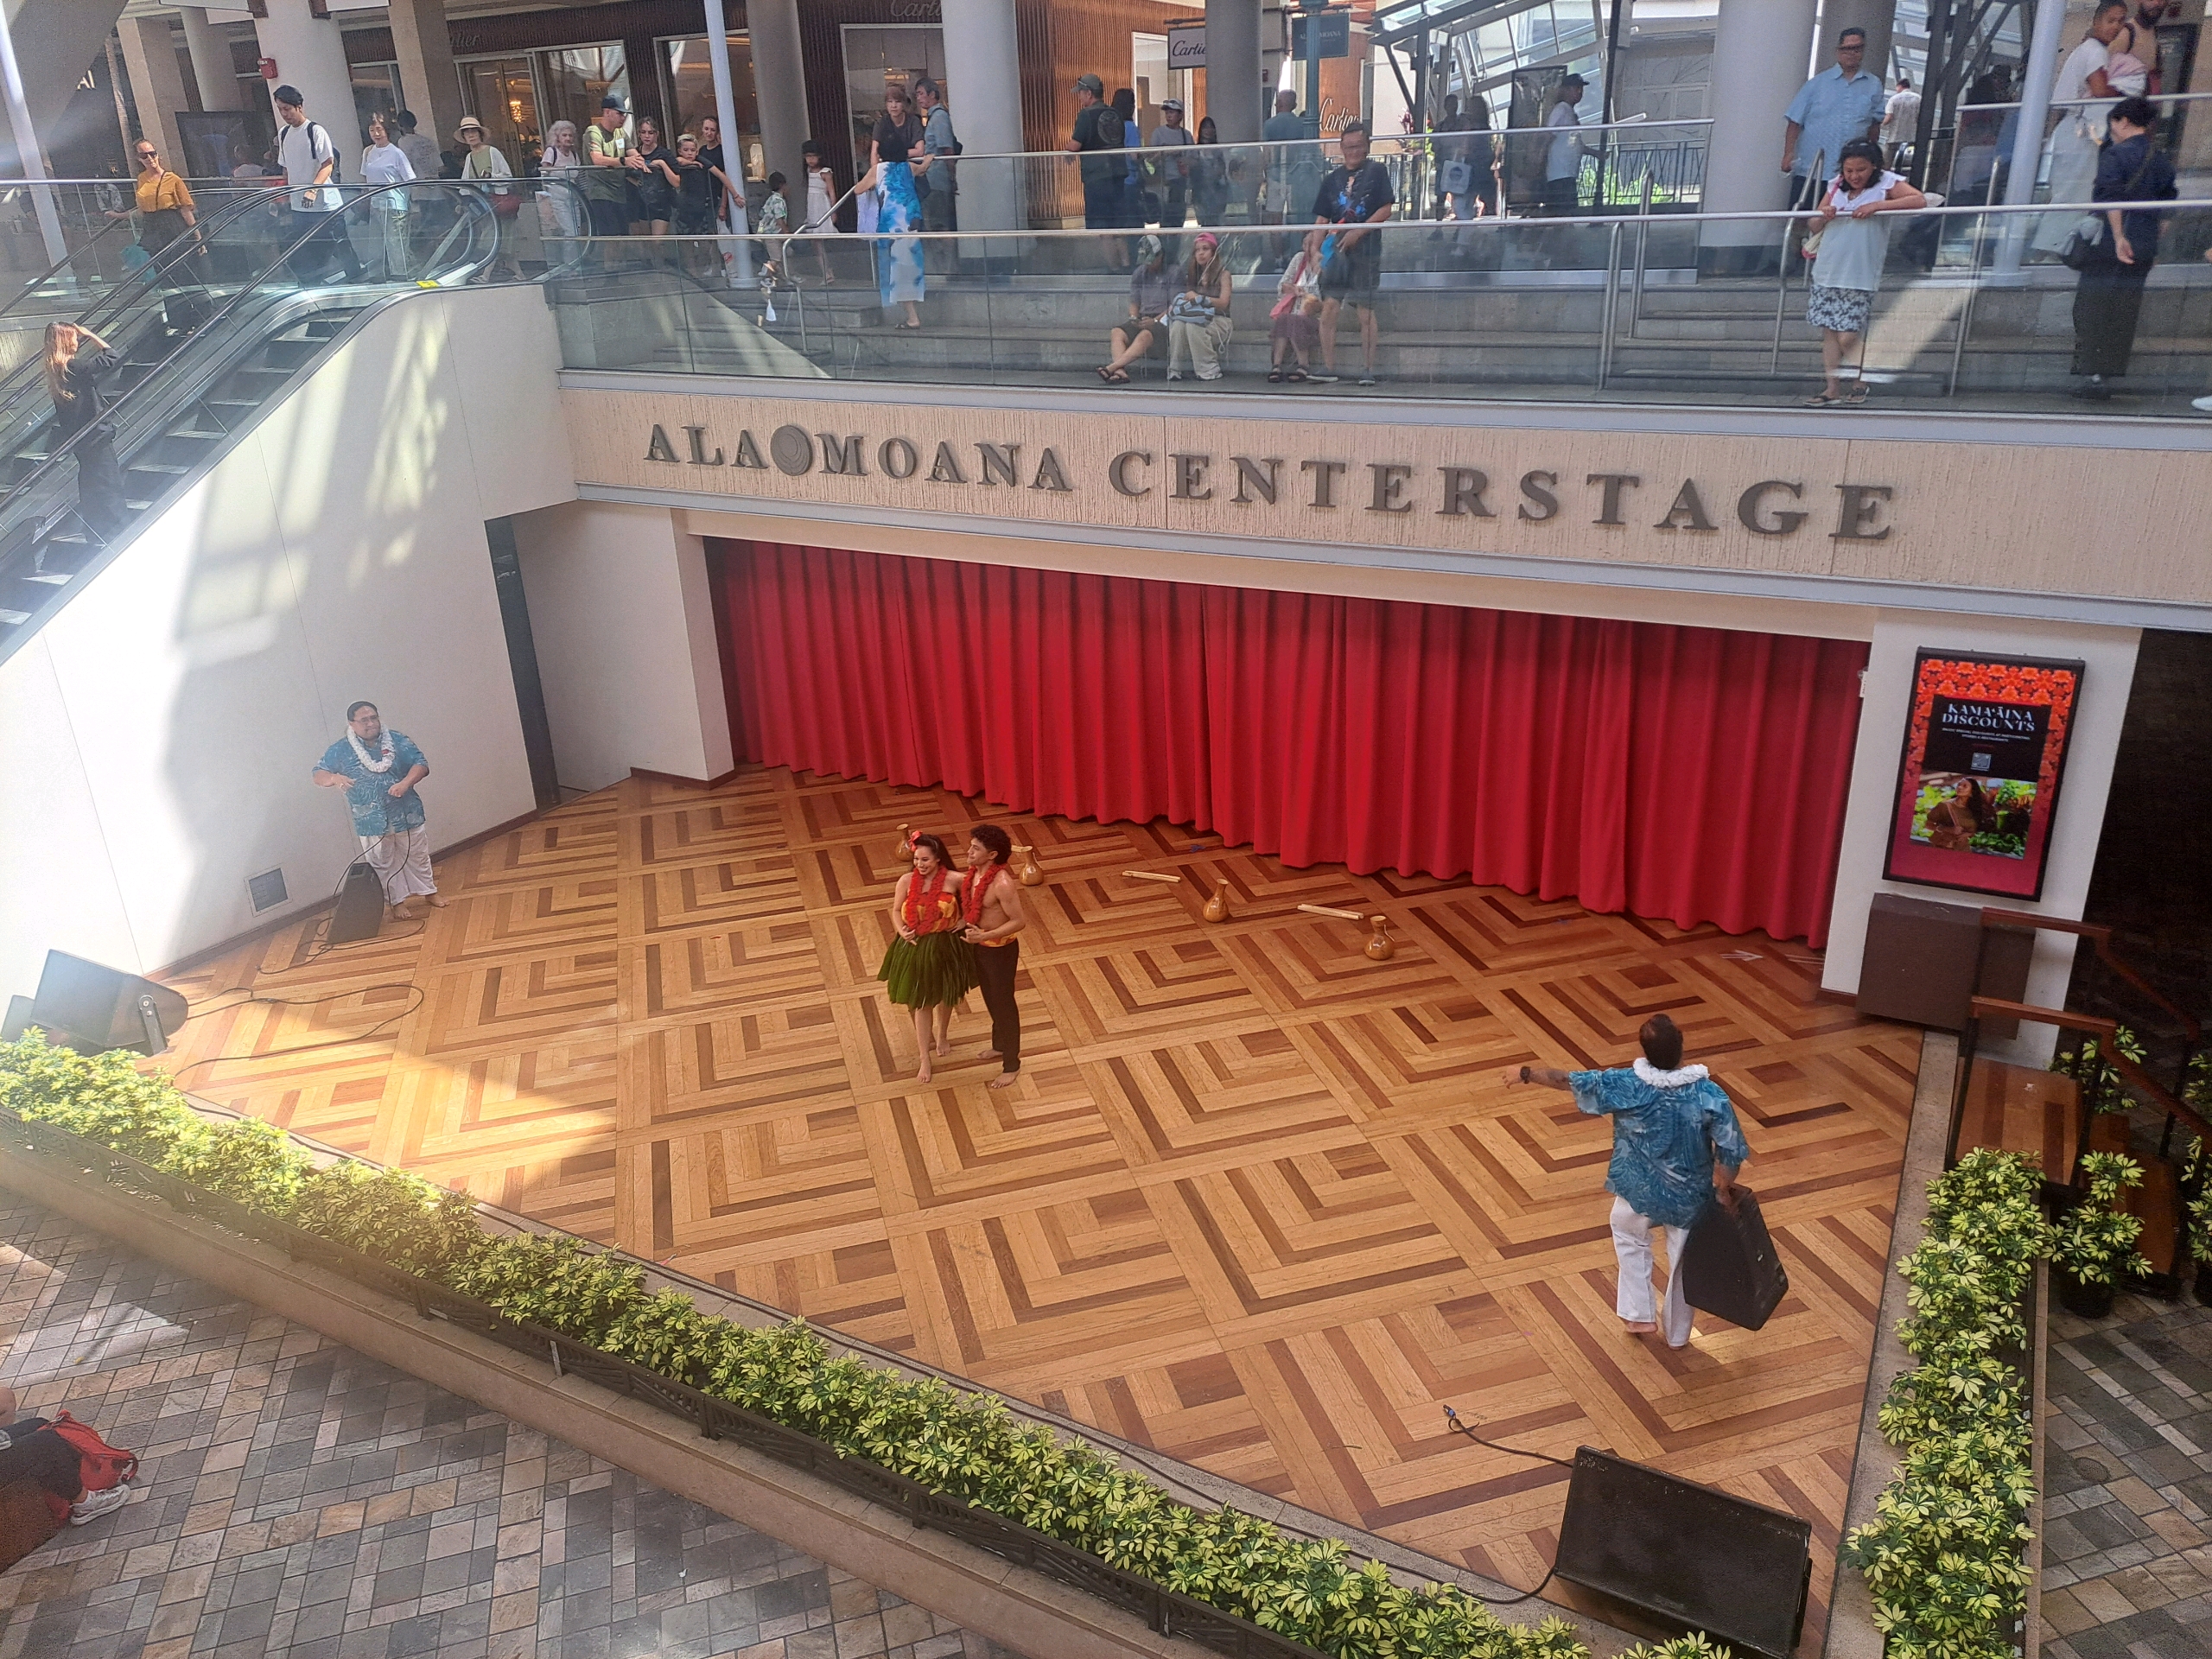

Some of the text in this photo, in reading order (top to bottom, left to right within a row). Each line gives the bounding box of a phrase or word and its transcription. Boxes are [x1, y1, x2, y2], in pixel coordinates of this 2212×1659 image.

[1172, 40, 1206, 57] Cartie
[644, 423, 769, 469] ALA
[815, 433, 1073, 492] MOANA
[1942, 713, 2035, 732] DISCOUNTS
